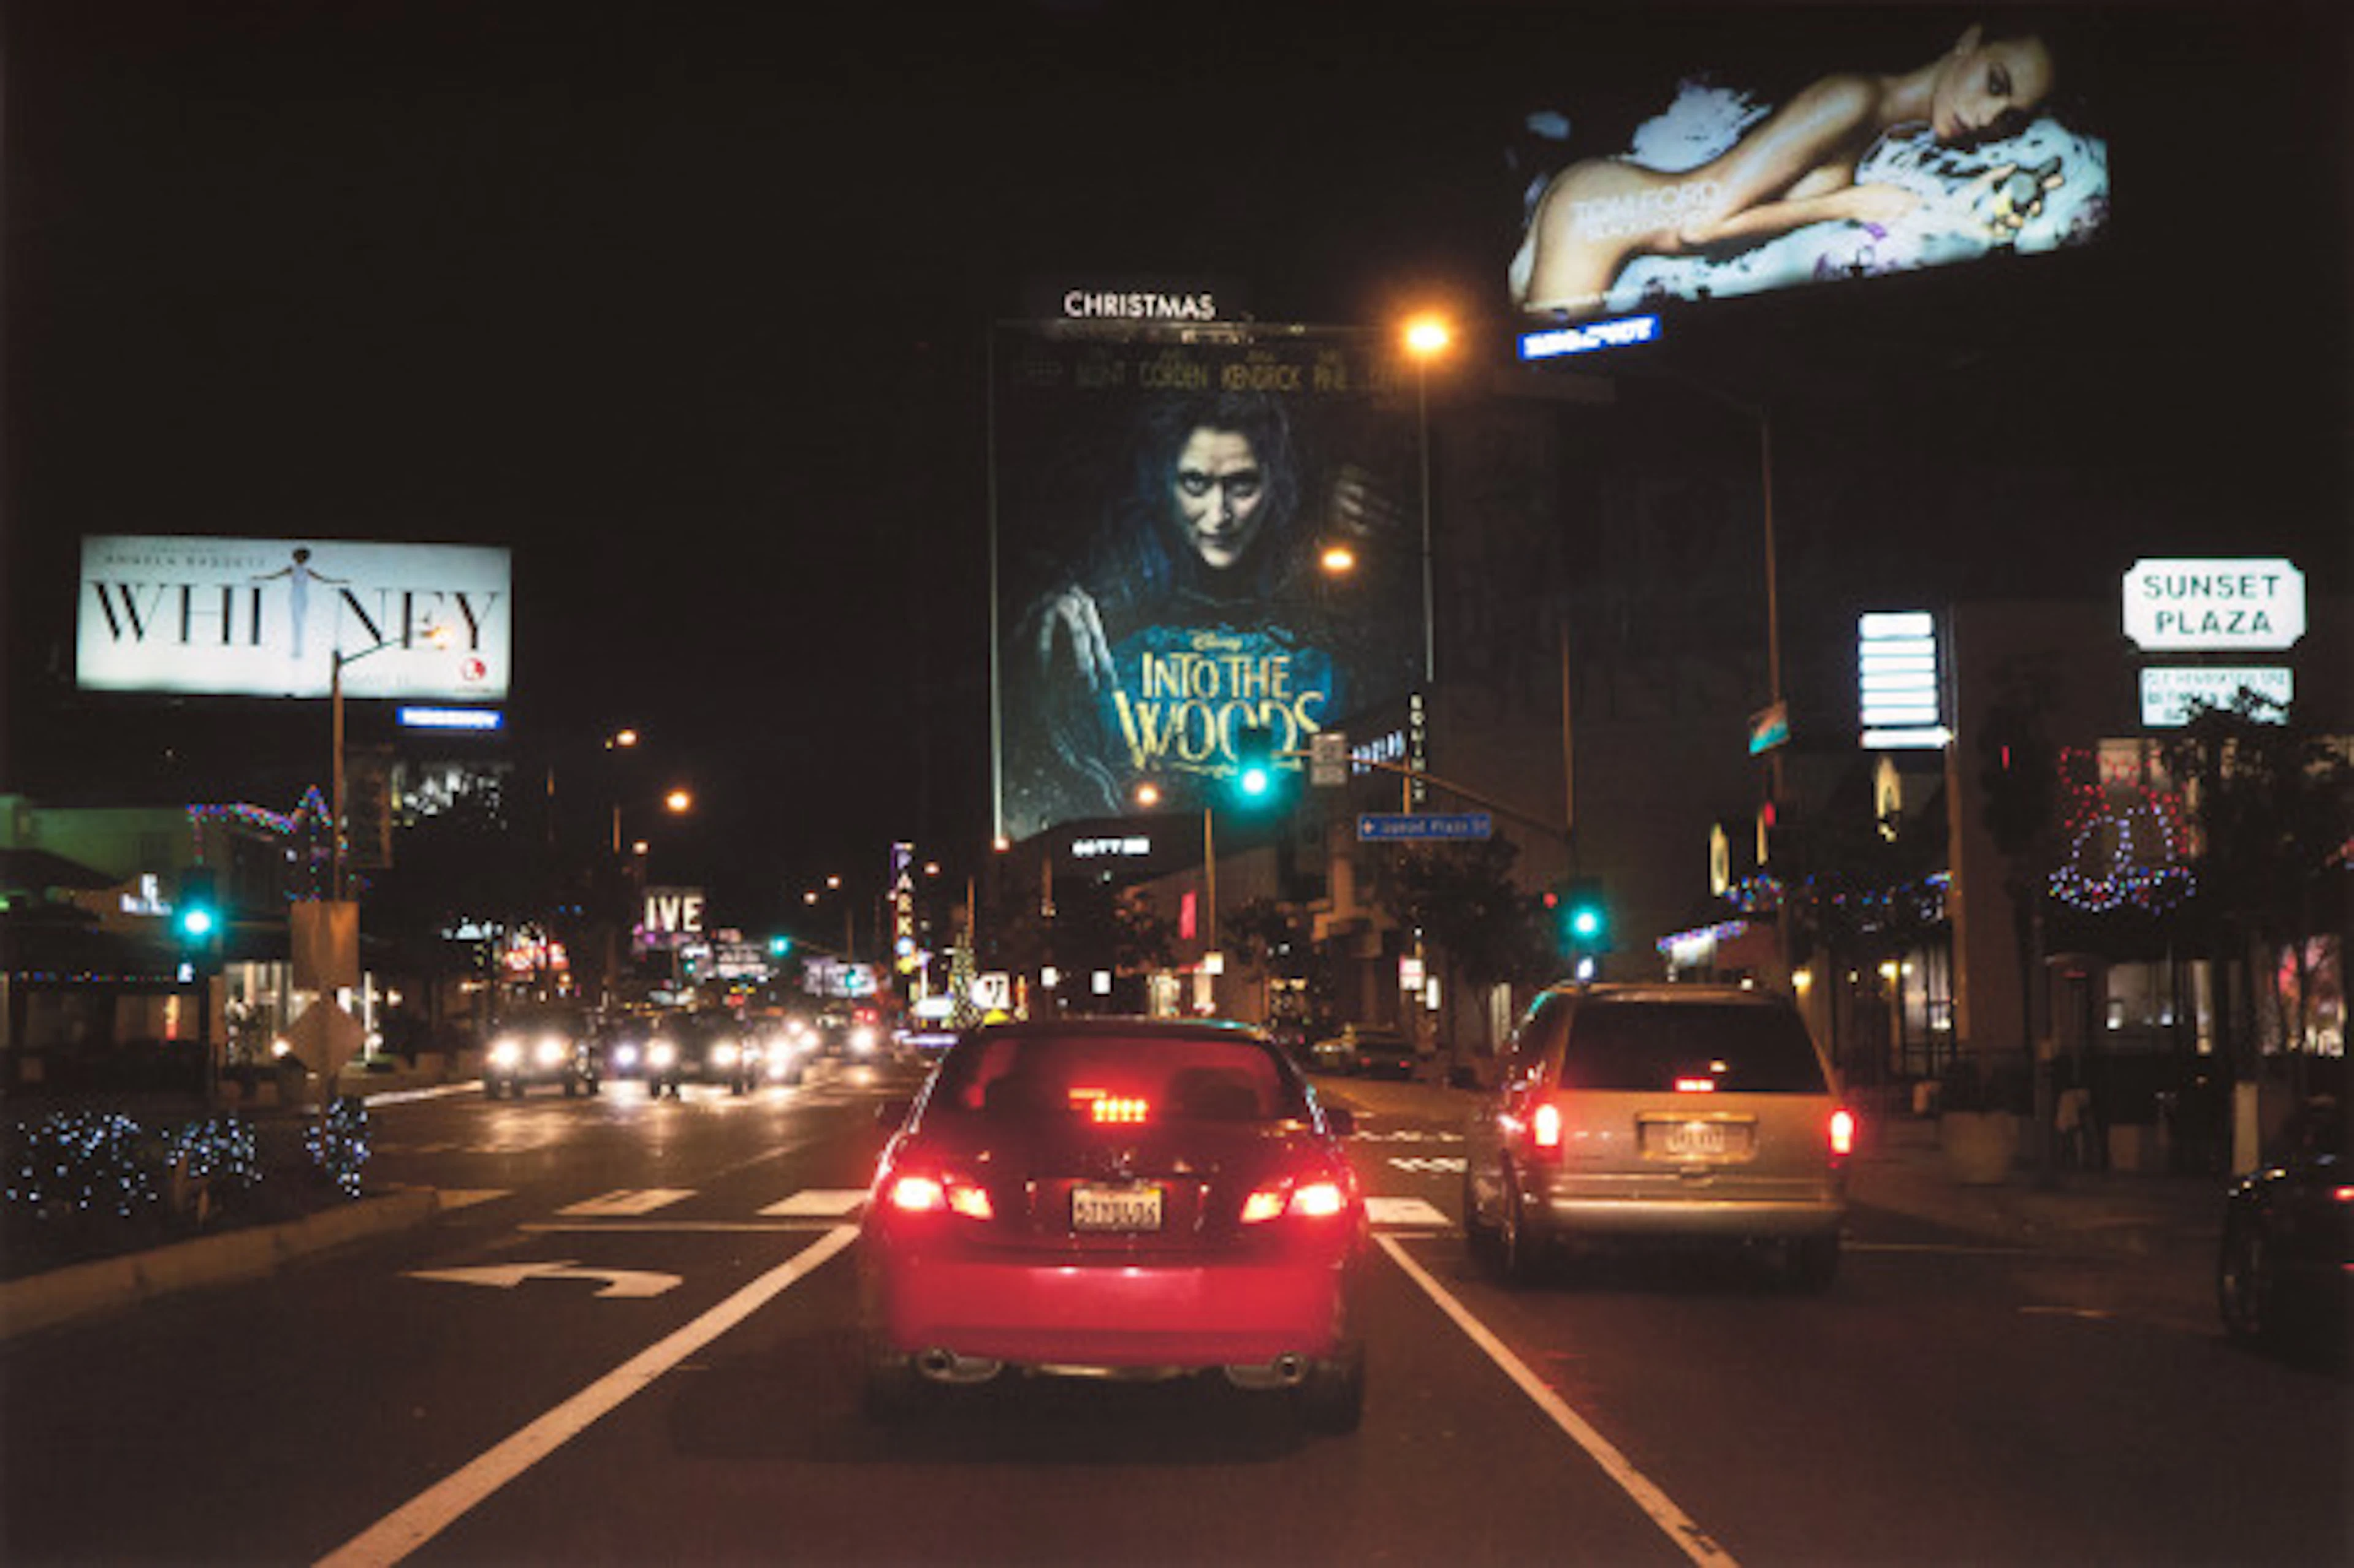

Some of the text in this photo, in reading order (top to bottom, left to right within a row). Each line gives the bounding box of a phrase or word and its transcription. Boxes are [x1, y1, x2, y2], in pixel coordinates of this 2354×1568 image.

[1063, 289, 1216, 321] CHRISTMAS
[2143, 574, 2280, 599] SUNSET
[86, 580, 503, 651] WHINEY
[2155, 610, 2273, 634] PLAZA
[1142, 651, 1291, 700] INTO THE
[1113, 689, 1325, 771] WOODS
